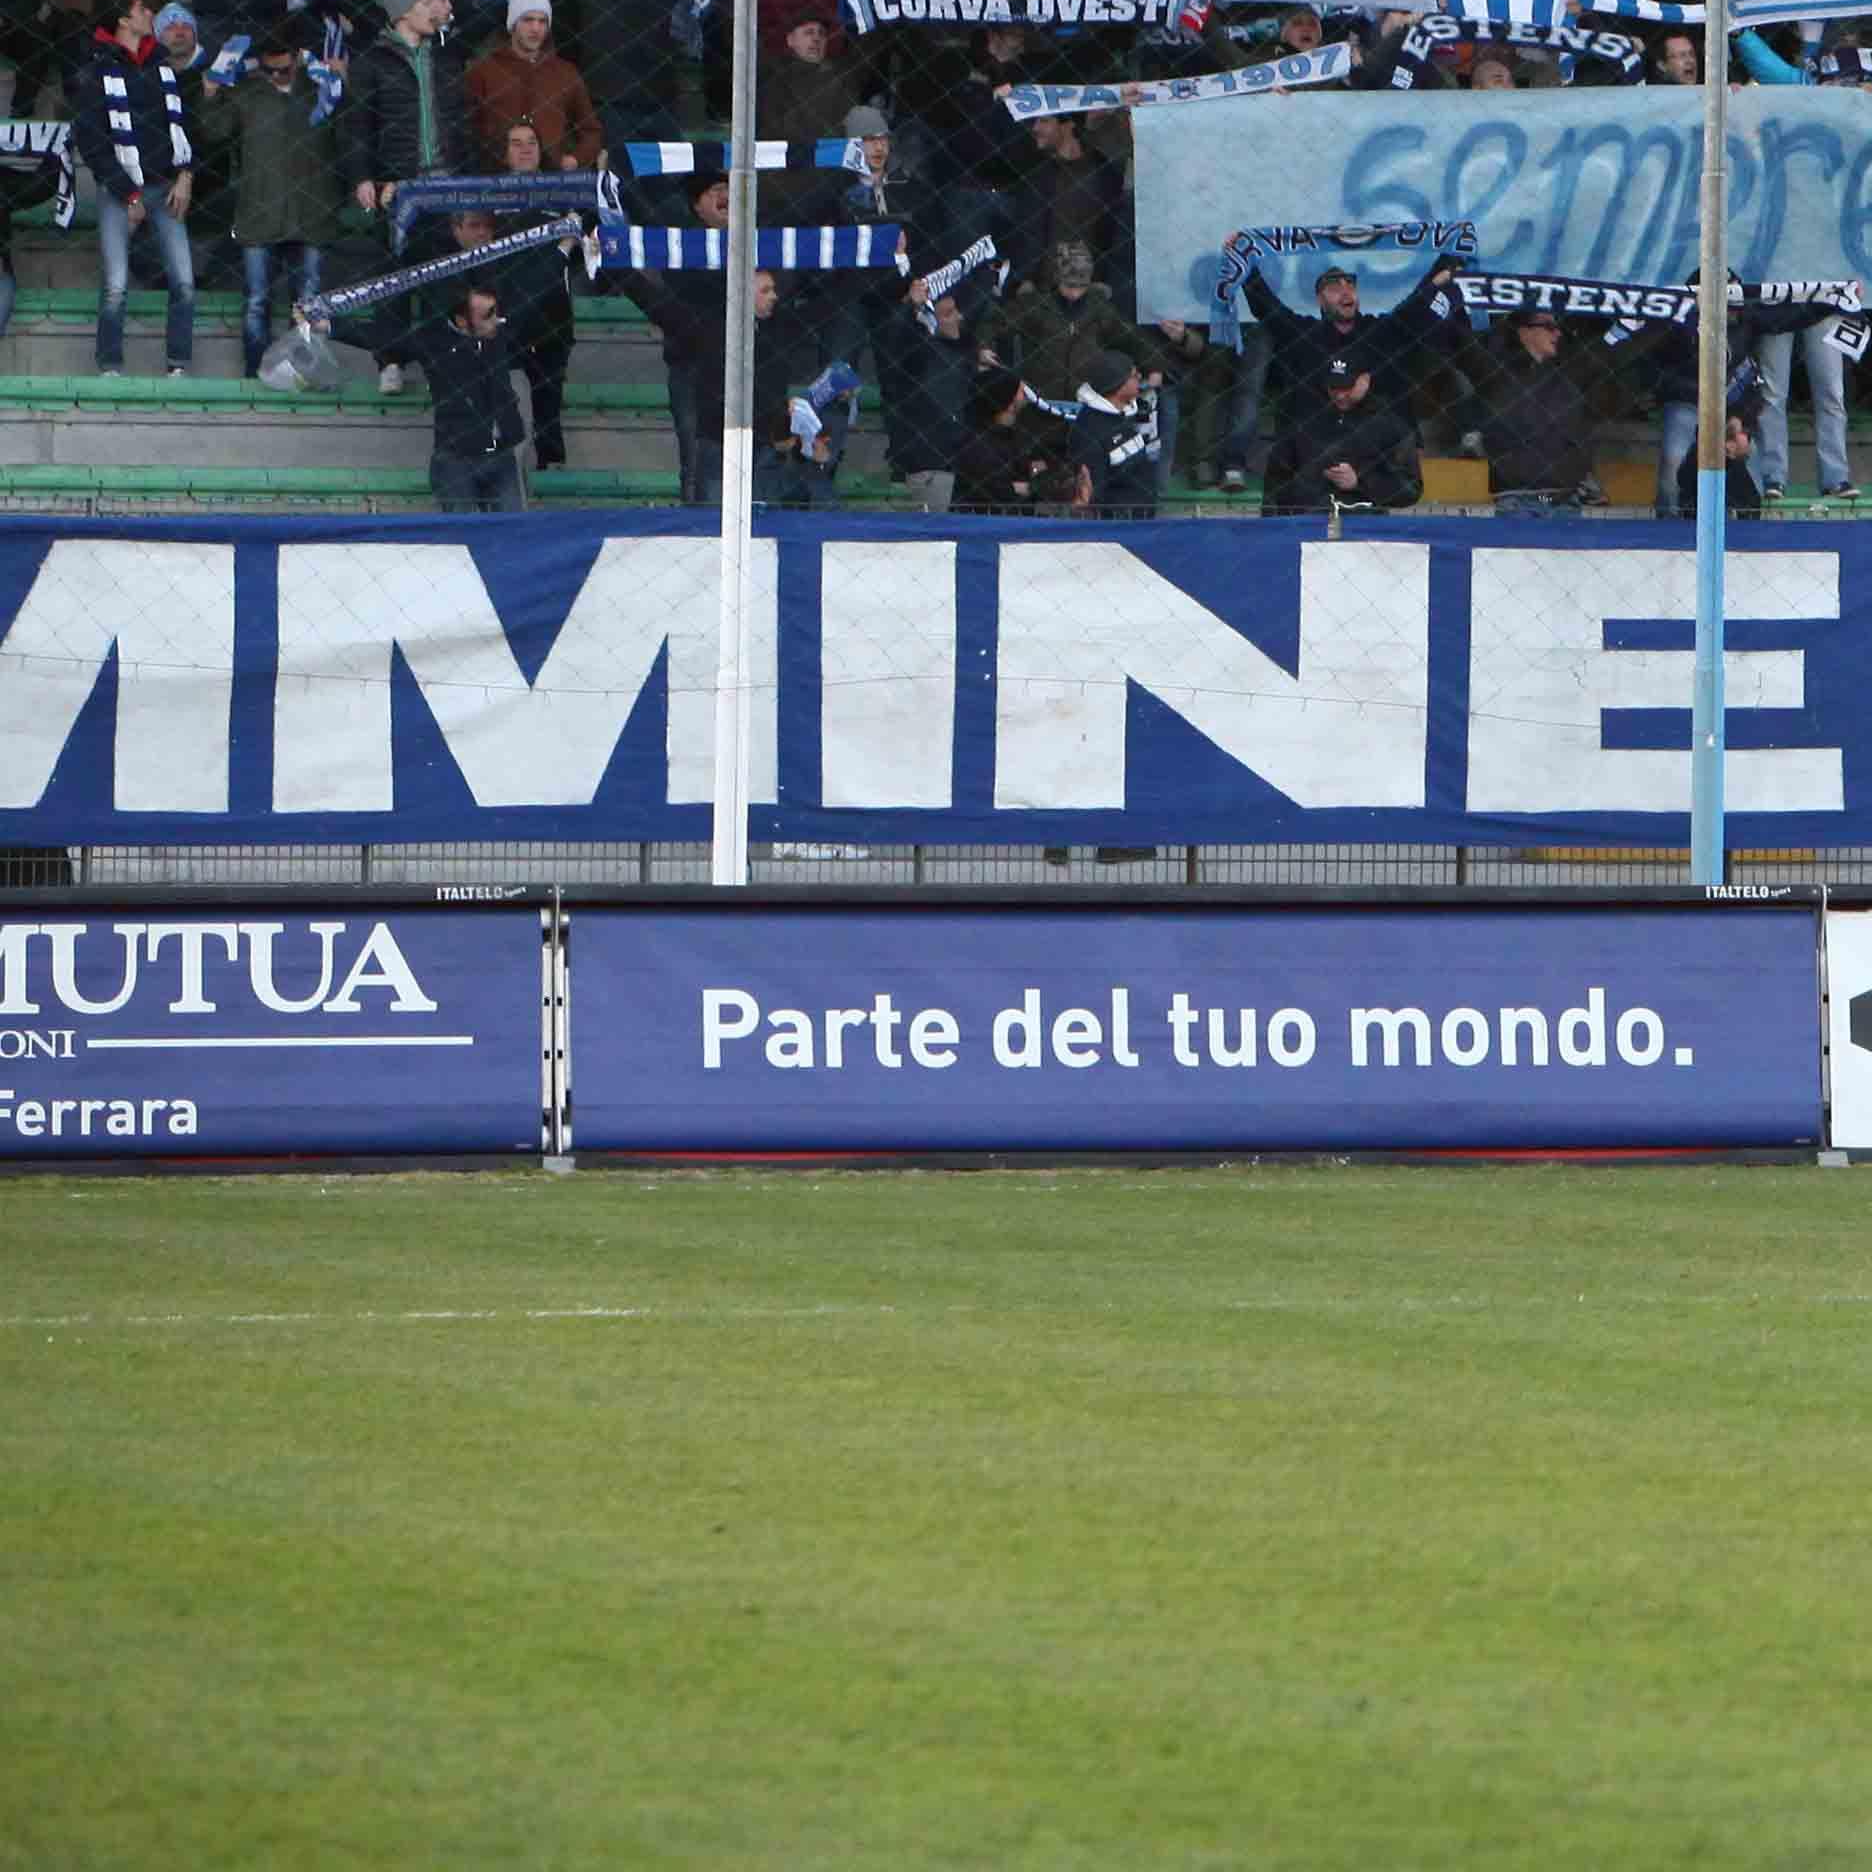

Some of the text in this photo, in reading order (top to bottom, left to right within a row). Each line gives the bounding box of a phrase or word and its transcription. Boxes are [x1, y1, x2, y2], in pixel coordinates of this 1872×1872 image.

[1221, 45, 1341, 93] 1907
[1461, 275, 1696, 321] ESTENSI
[436, 885, 505, 902] ITALTELO
[1705, 885, 1769, 900] ITALTELO
[702, 984, 1696, 1071] Parte del tuo mondo.
